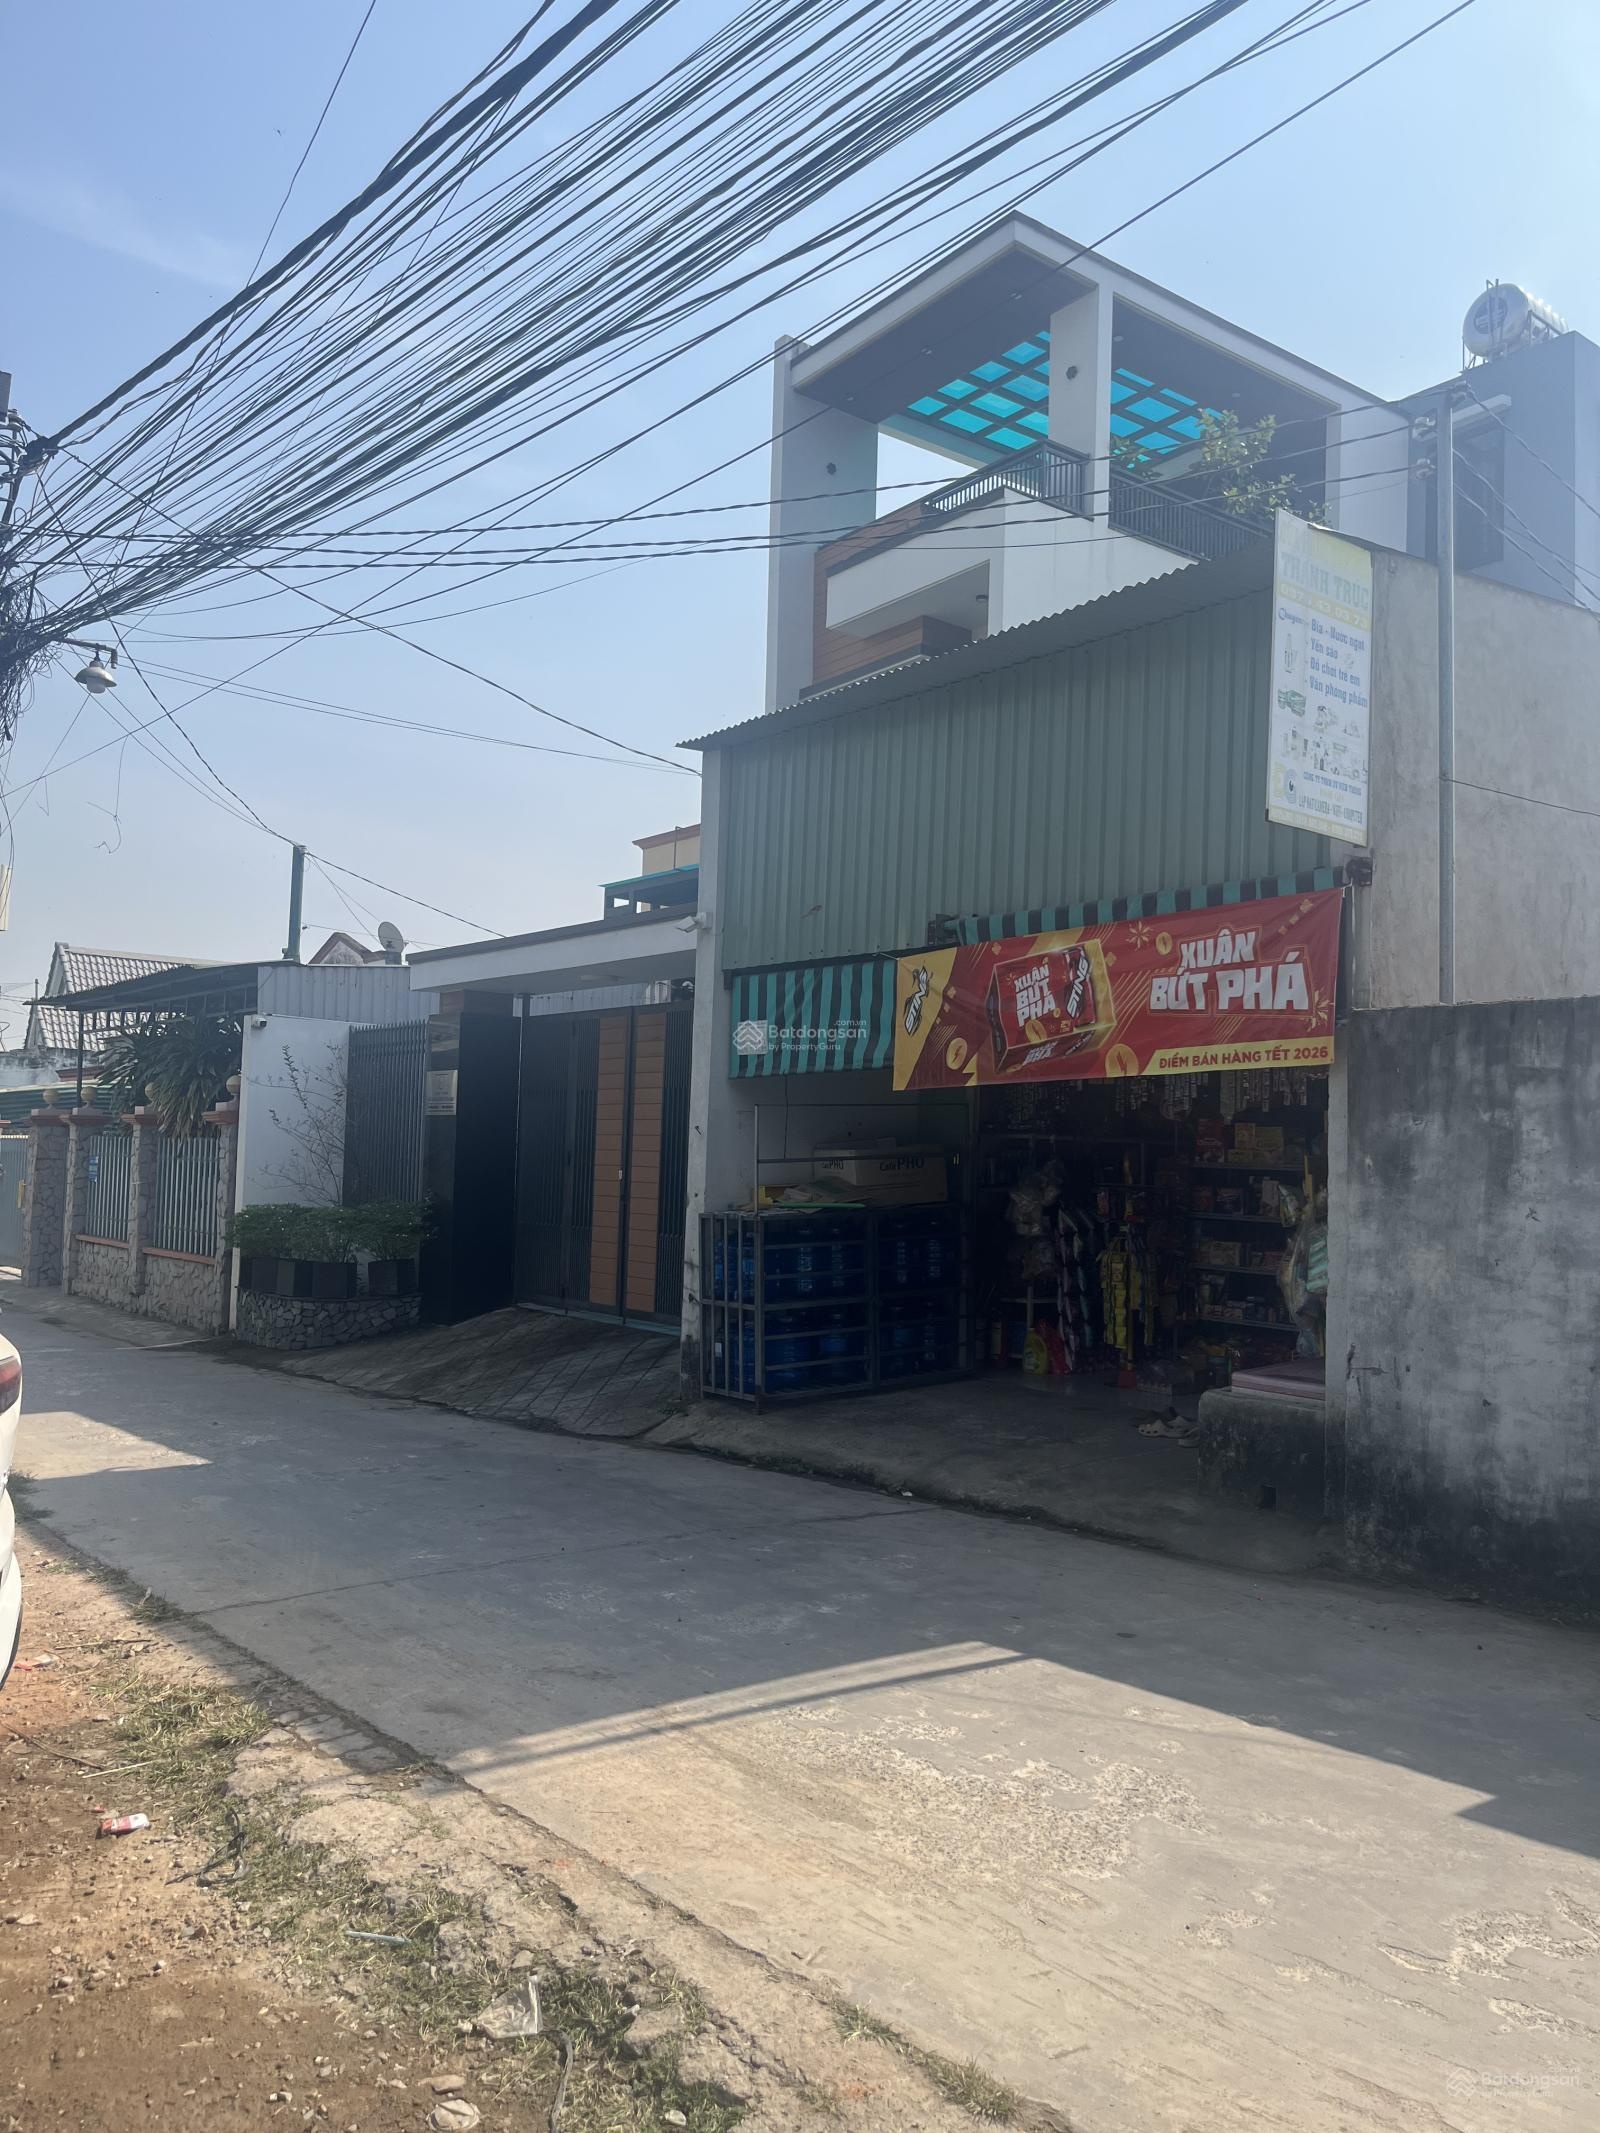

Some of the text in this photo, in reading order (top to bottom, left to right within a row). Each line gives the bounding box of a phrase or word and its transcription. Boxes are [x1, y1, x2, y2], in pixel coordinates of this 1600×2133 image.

[1180, 928, 1256, 969] XUÂN
[905, 966, 929, 1034] STING
[1066, 956, 1090, 1018] STING
[1215, 951, 1309, 1010] PHÁ
[1192, 1051, 1218, 1067] BÁN
[1221, 1048, 1262, 1065] HÀNG
[1265, 1044, 1291, 1061] TẾT
[1293, 1046, 1328, 1060] 2026
